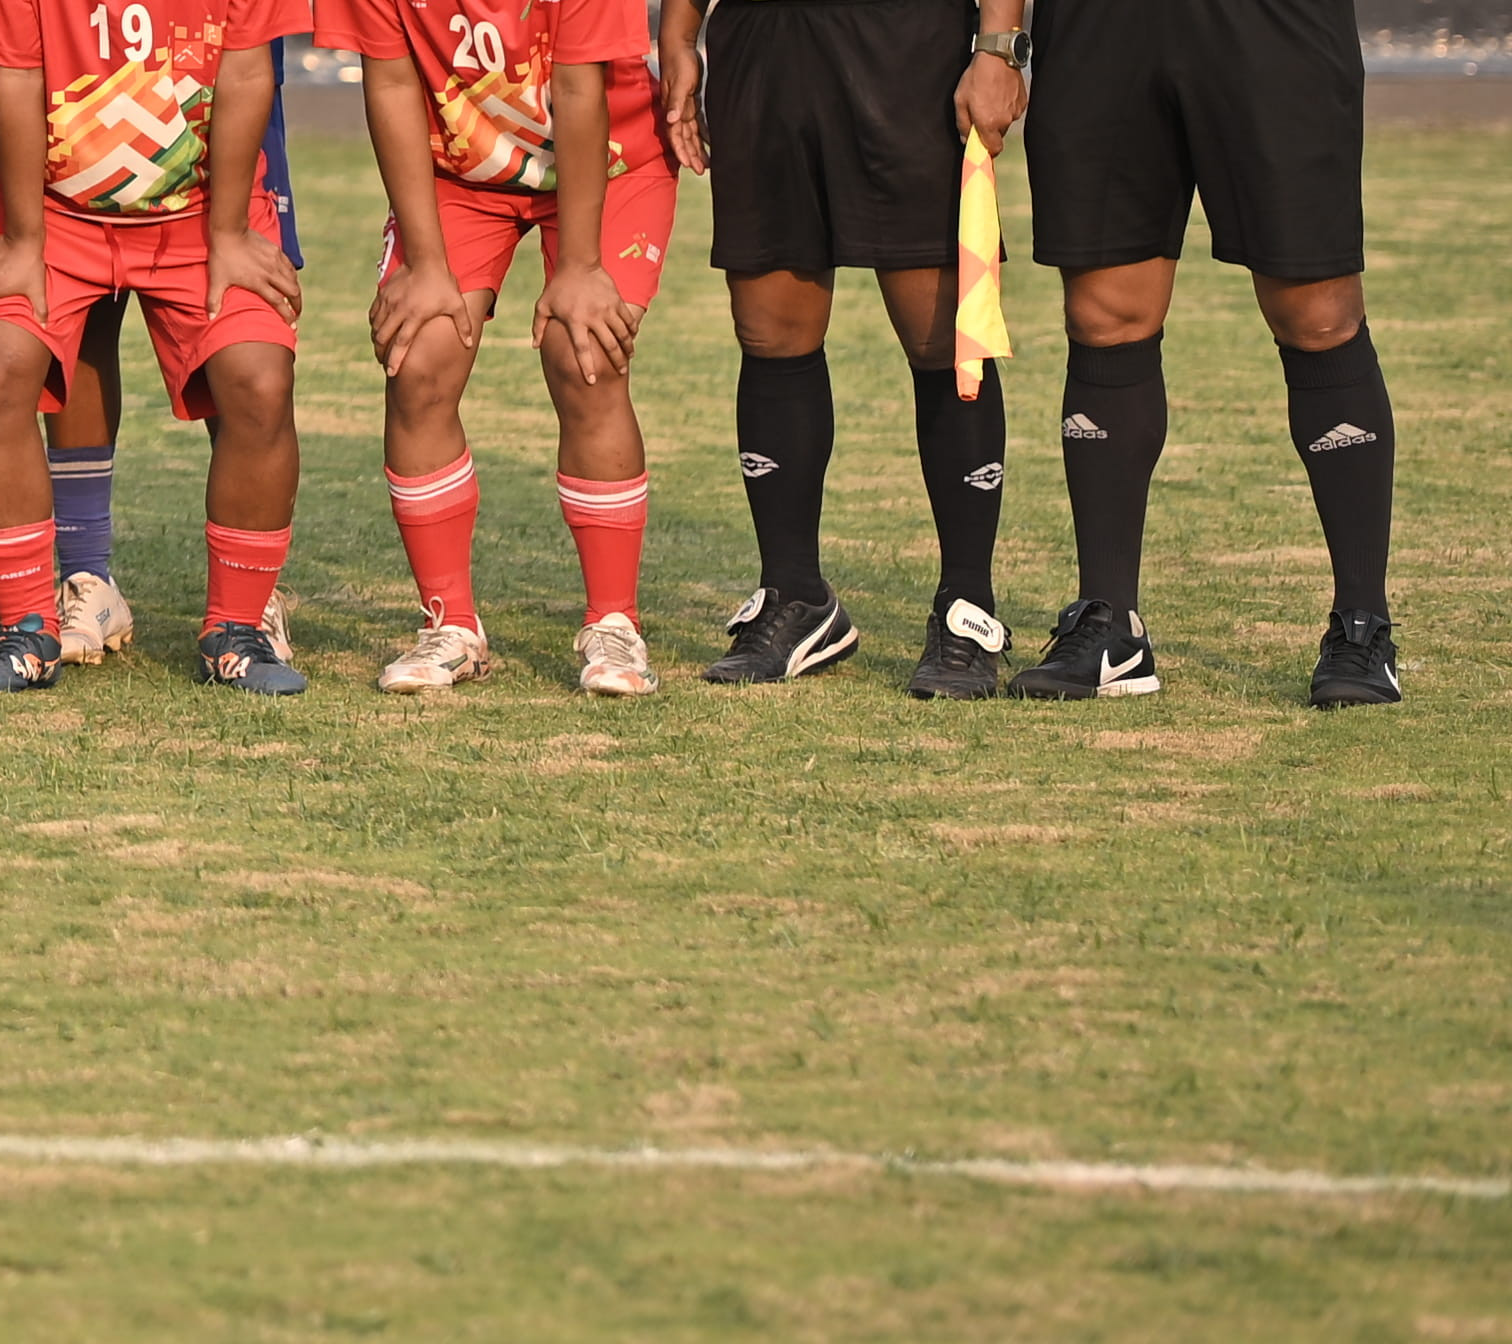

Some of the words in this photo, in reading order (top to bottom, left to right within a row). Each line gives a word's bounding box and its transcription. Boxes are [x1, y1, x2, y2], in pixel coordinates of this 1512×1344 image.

[89, 3, 152, 62] 19
[448, 13, 505, 73] 20
[1309, 432, 1378, 452] adidas
